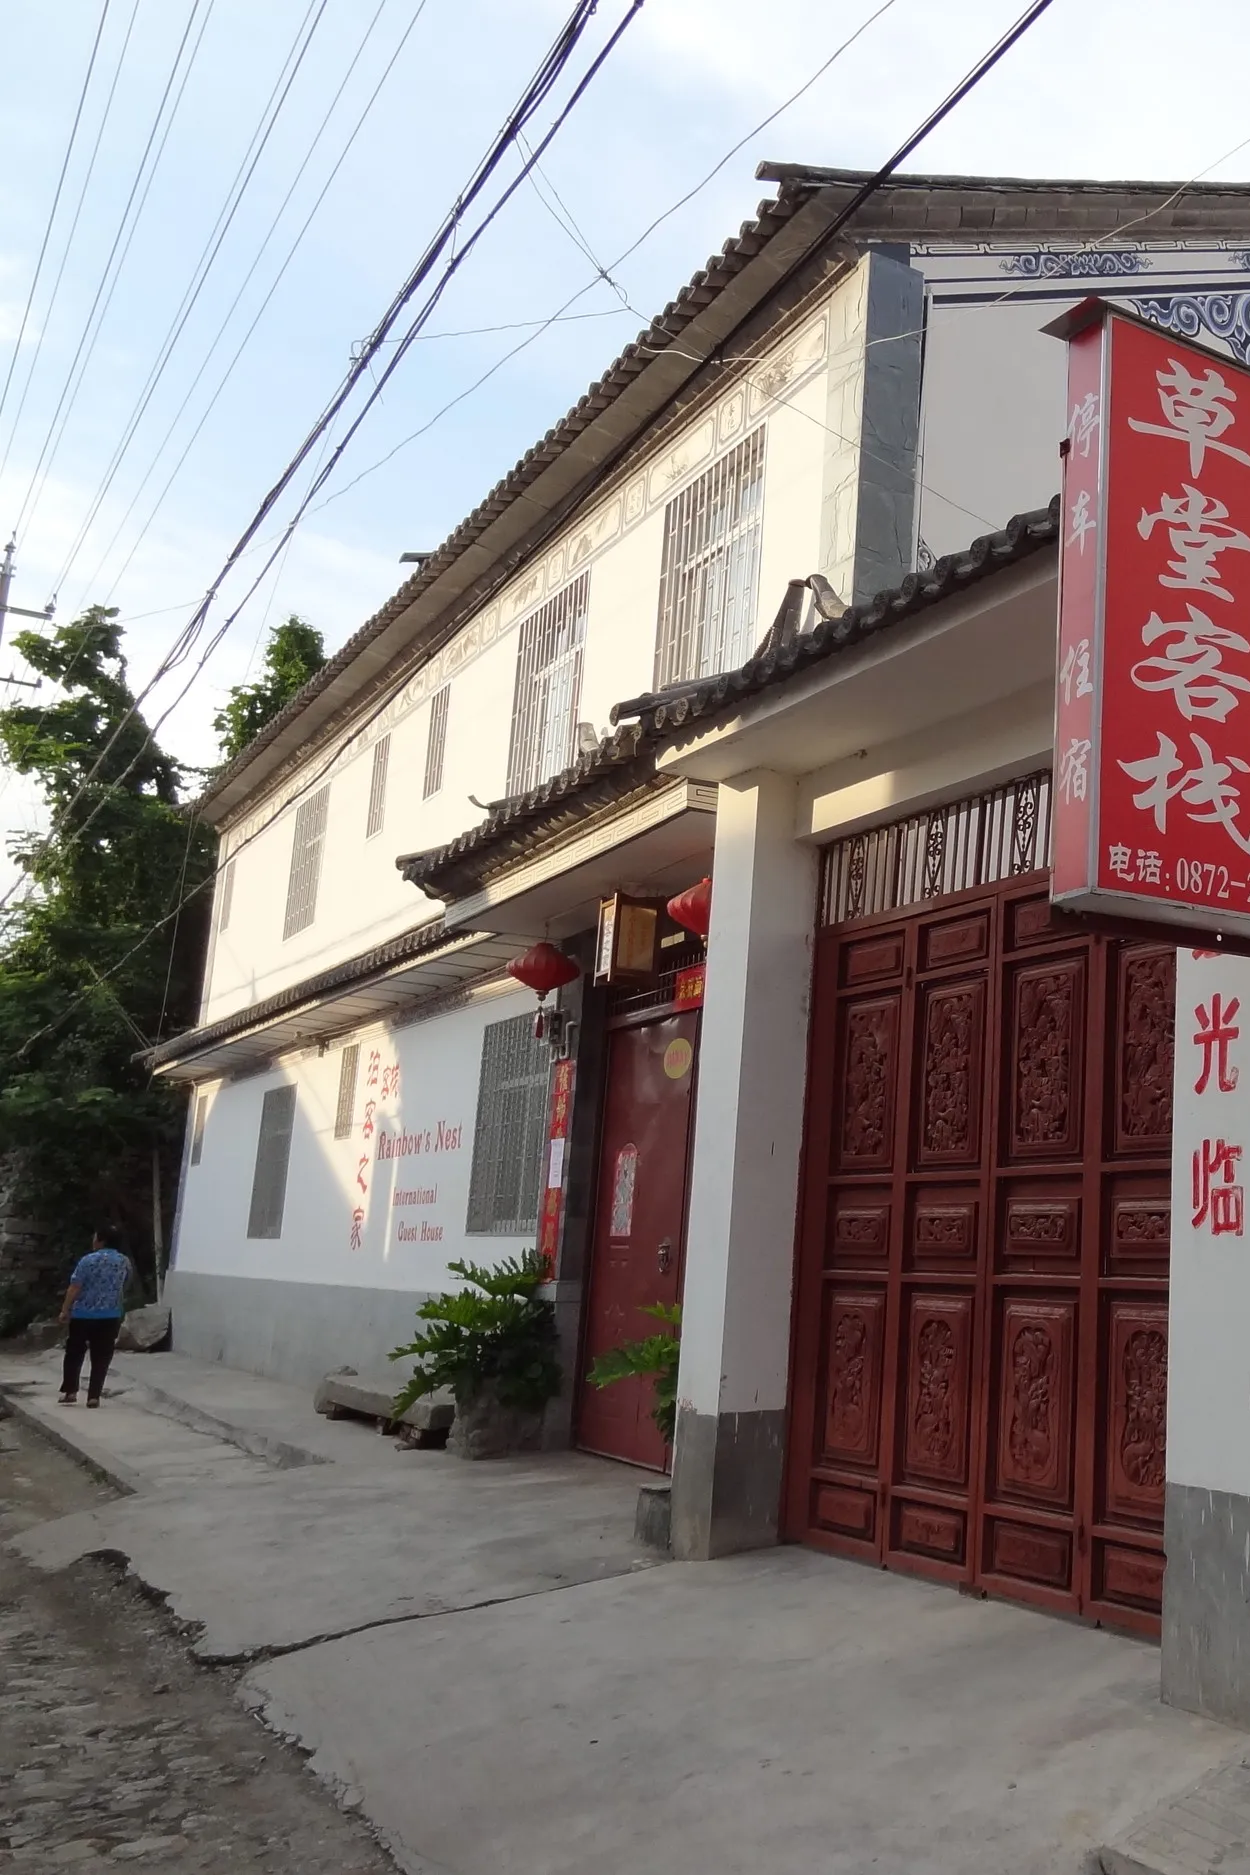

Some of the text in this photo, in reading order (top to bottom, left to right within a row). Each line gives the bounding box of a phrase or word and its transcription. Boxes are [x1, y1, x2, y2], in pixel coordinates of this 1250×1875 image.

[1191, 949, 1244, 1237] 光临
[377, 1119, 463, 1160] Rainbow's Nest
[392, 1184, 437, 1206] International
[397, 1221, 443, 1242] Guest House
